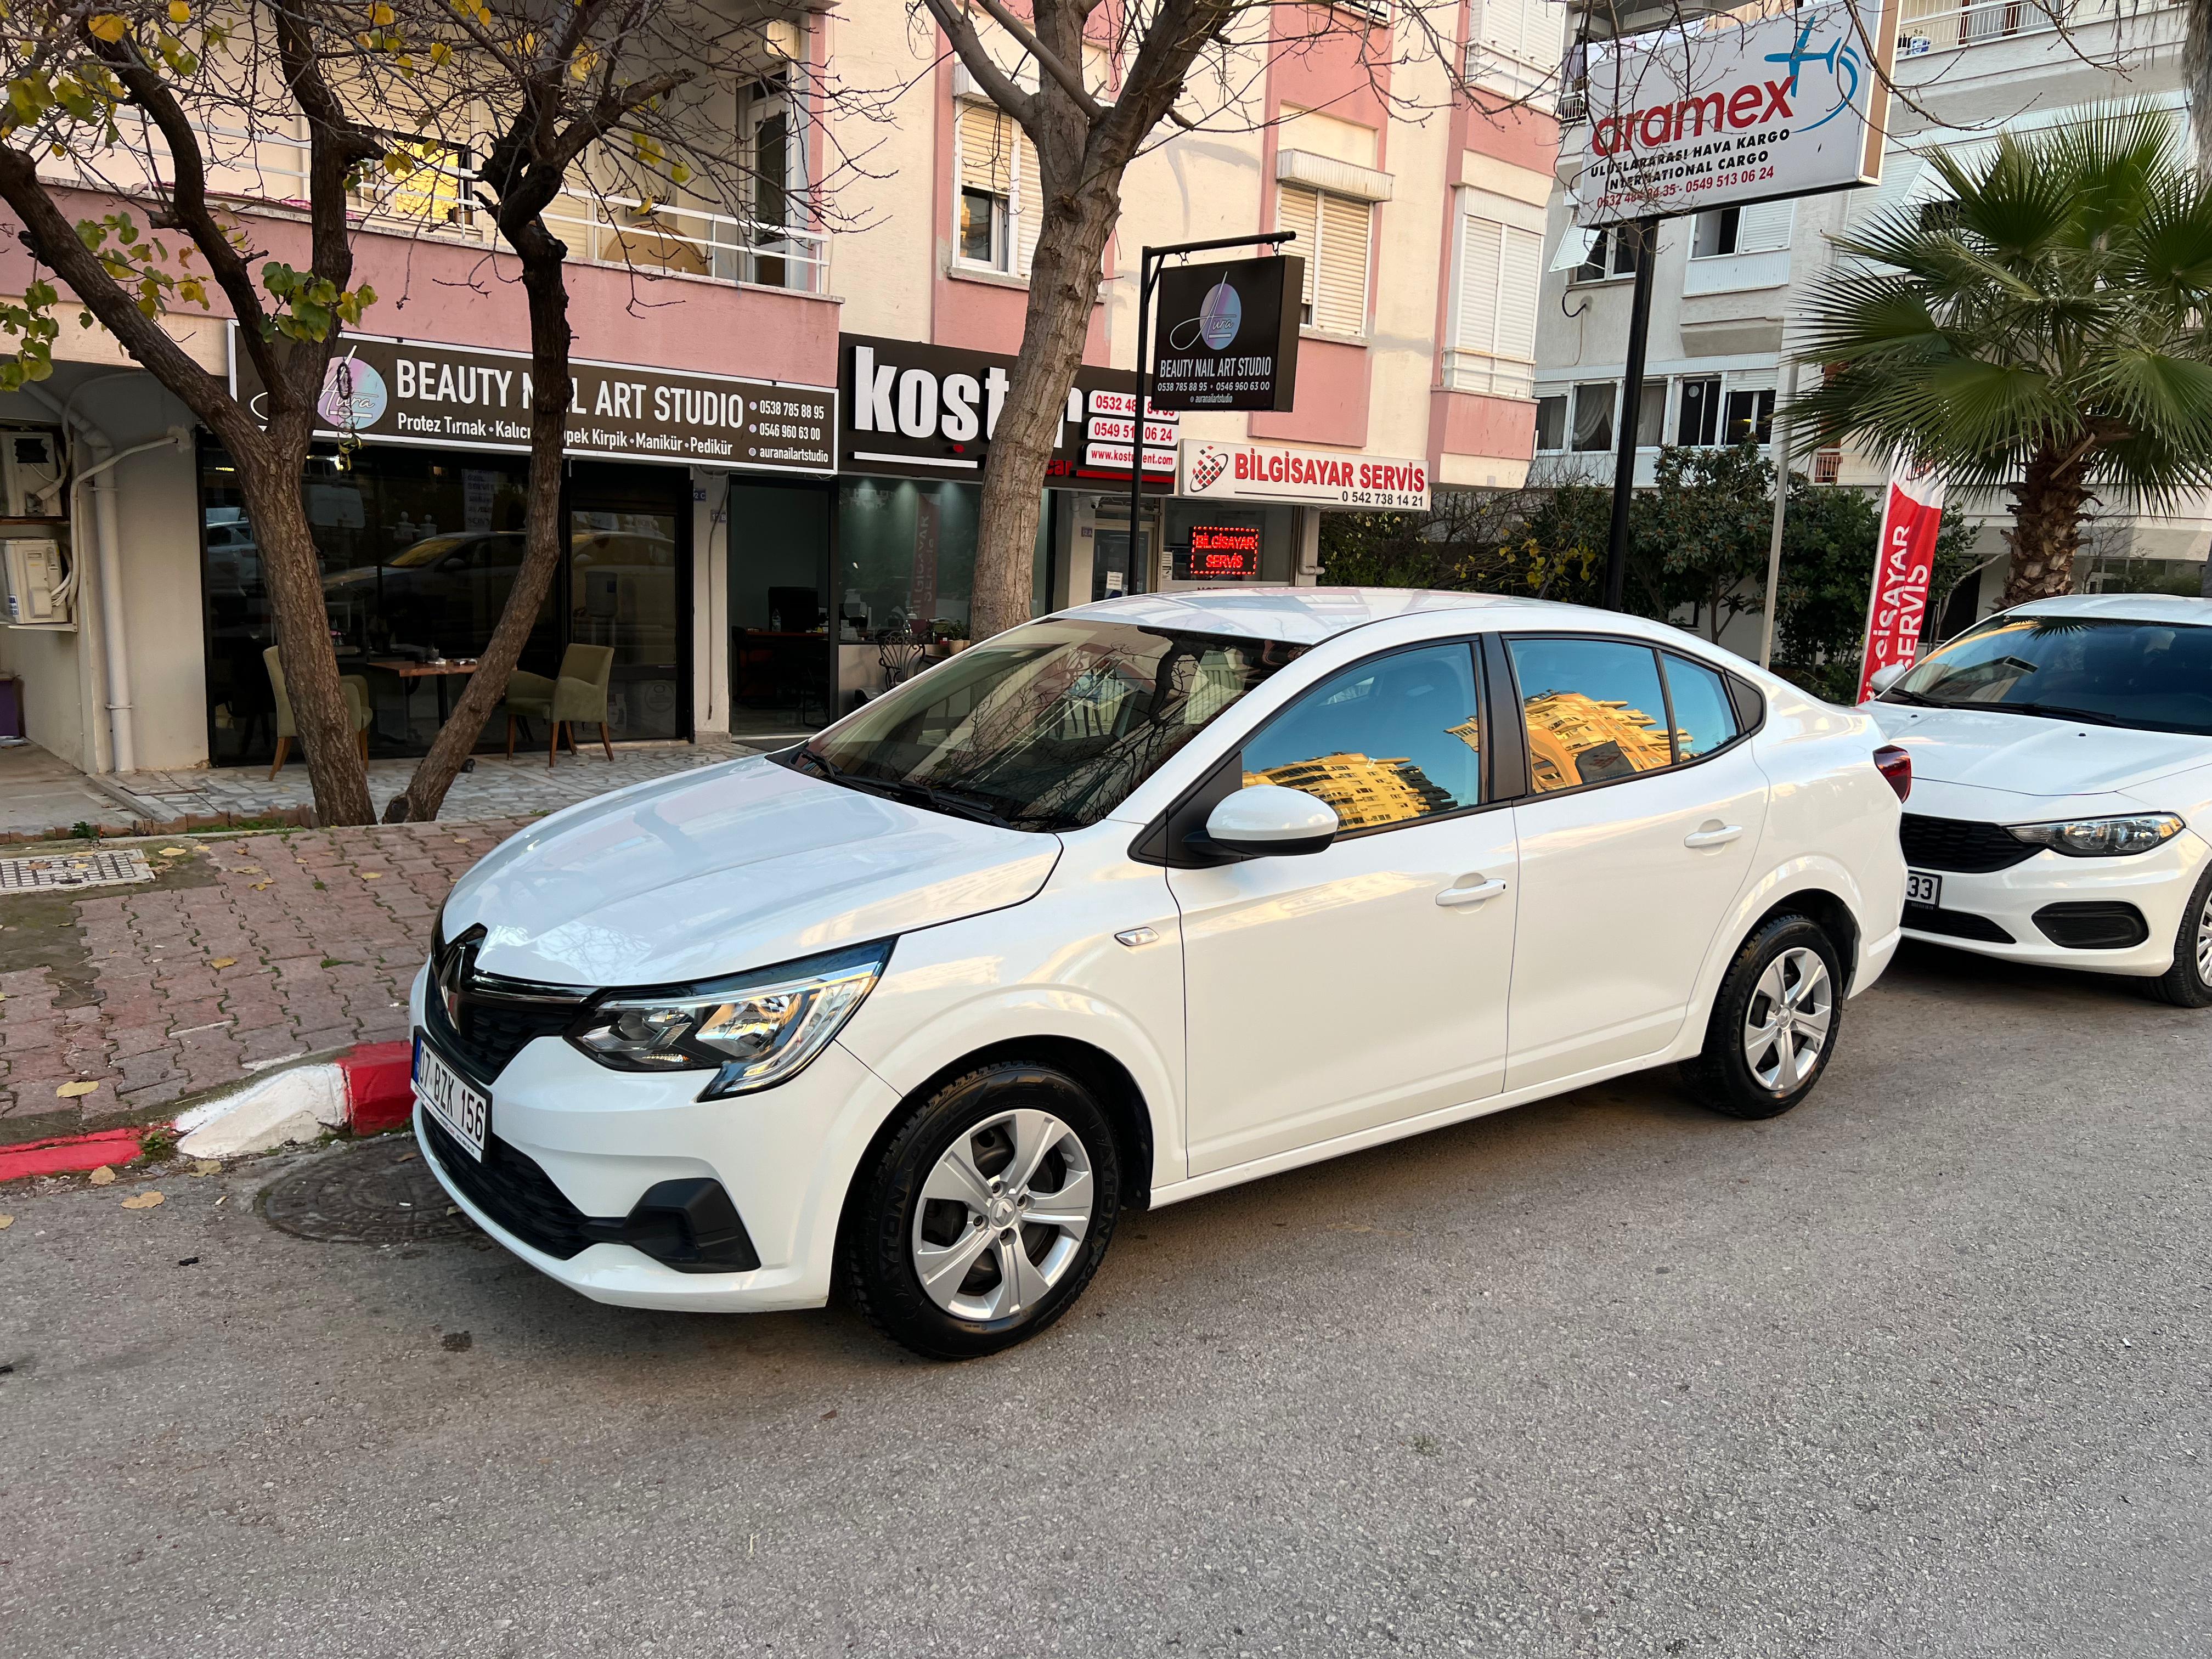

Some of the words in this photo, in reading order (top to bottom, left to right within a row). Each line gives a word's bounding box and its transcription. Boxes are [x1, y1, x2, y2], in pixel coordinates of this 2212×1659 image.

[1592, 75, 1796, 157] aramex
[1694, 141, 1731, 162] HAVA
[1736, 129, 1790, 149] KARGO
[1718, 151, 1768, 170] CARGO
[1686, 177, 1713, 193] 0549
[1717, 173, 1737, 188] 513
[1741, 170, 1756, 184] 06
[1759, 166, 1774, 180] 24
[1170, 271, 1237, 350] Aura
[1160, 359, 1194, 377] BEAUTY
[1195, 358, 1215, 377] NAIL
[1217, 358, 1236, 377] ART
[1237, 357, 1272, 376] STUDIO
[397, 359, 512, 408] BEAUTY
[595, 381, 647, 419] ART
[654, 386, 743, 428] STUDIO
[1158, 382, 1174, 391] 0538
[1176, 382, 1187, 391] 785
[1189, 382, 1197, 391] 88
[1199, 382, 1207, 391] 95
[1216, 382, 1233, 391] 0546
[1235, 382, 1248, 391] 960
[1250, 382, 1259, 390] 63
[1260, 382, 1270, 390] 00
[760, 400, 781, 415] 0538
[783, 402, 799, 417] 785
[801, 404, 811, 418] 88
[814, 405, 824, 420] 95
[1096, 395, 1121, 410] 0532
[398, 413, 441, 432] Protez
[444, 415, 486, 436] Tırnak
[496, 420, 531, 439] Kalıcı
[564, 428, 589, 447] pek
[592, 428, 628, 450] Kirpik
[636, 432, 682, 451] Manikür
[690, 437, 733, 455] Pedikür
[760, 422, 780, 437] 0546
[782, 425, 796, 438] 960
[799, 426, 808, 439] 63
[811, 427, 820, 441] 00
[1094, 422, 1120, 437] 0549
[1145, 426, 1156, 440] 06
[1160, 428, 1172, 441] 24
[760, 447, 828, 462] auranailartstudio
[1234, 448, 1353, 487] BİLGİSAYAR
[1359, 461, 1425, 492] SERVİS
[1342, 491, 1348, 502] 0
[1352, 492, 1371, 504] 542
[1375, 493, 1393, 505] 738
[1397, 494, 1409, 505] 14
[1412, 495, 1423, 506] 21
[1205, 552, 1244, 568] SERVİS
[1907, 876, 1933, 900] 33
[420, 1046, 431, 1088] 07
[434, 1062, 454, 1118] BZK
[461, 1088, 484, 1142] 156
